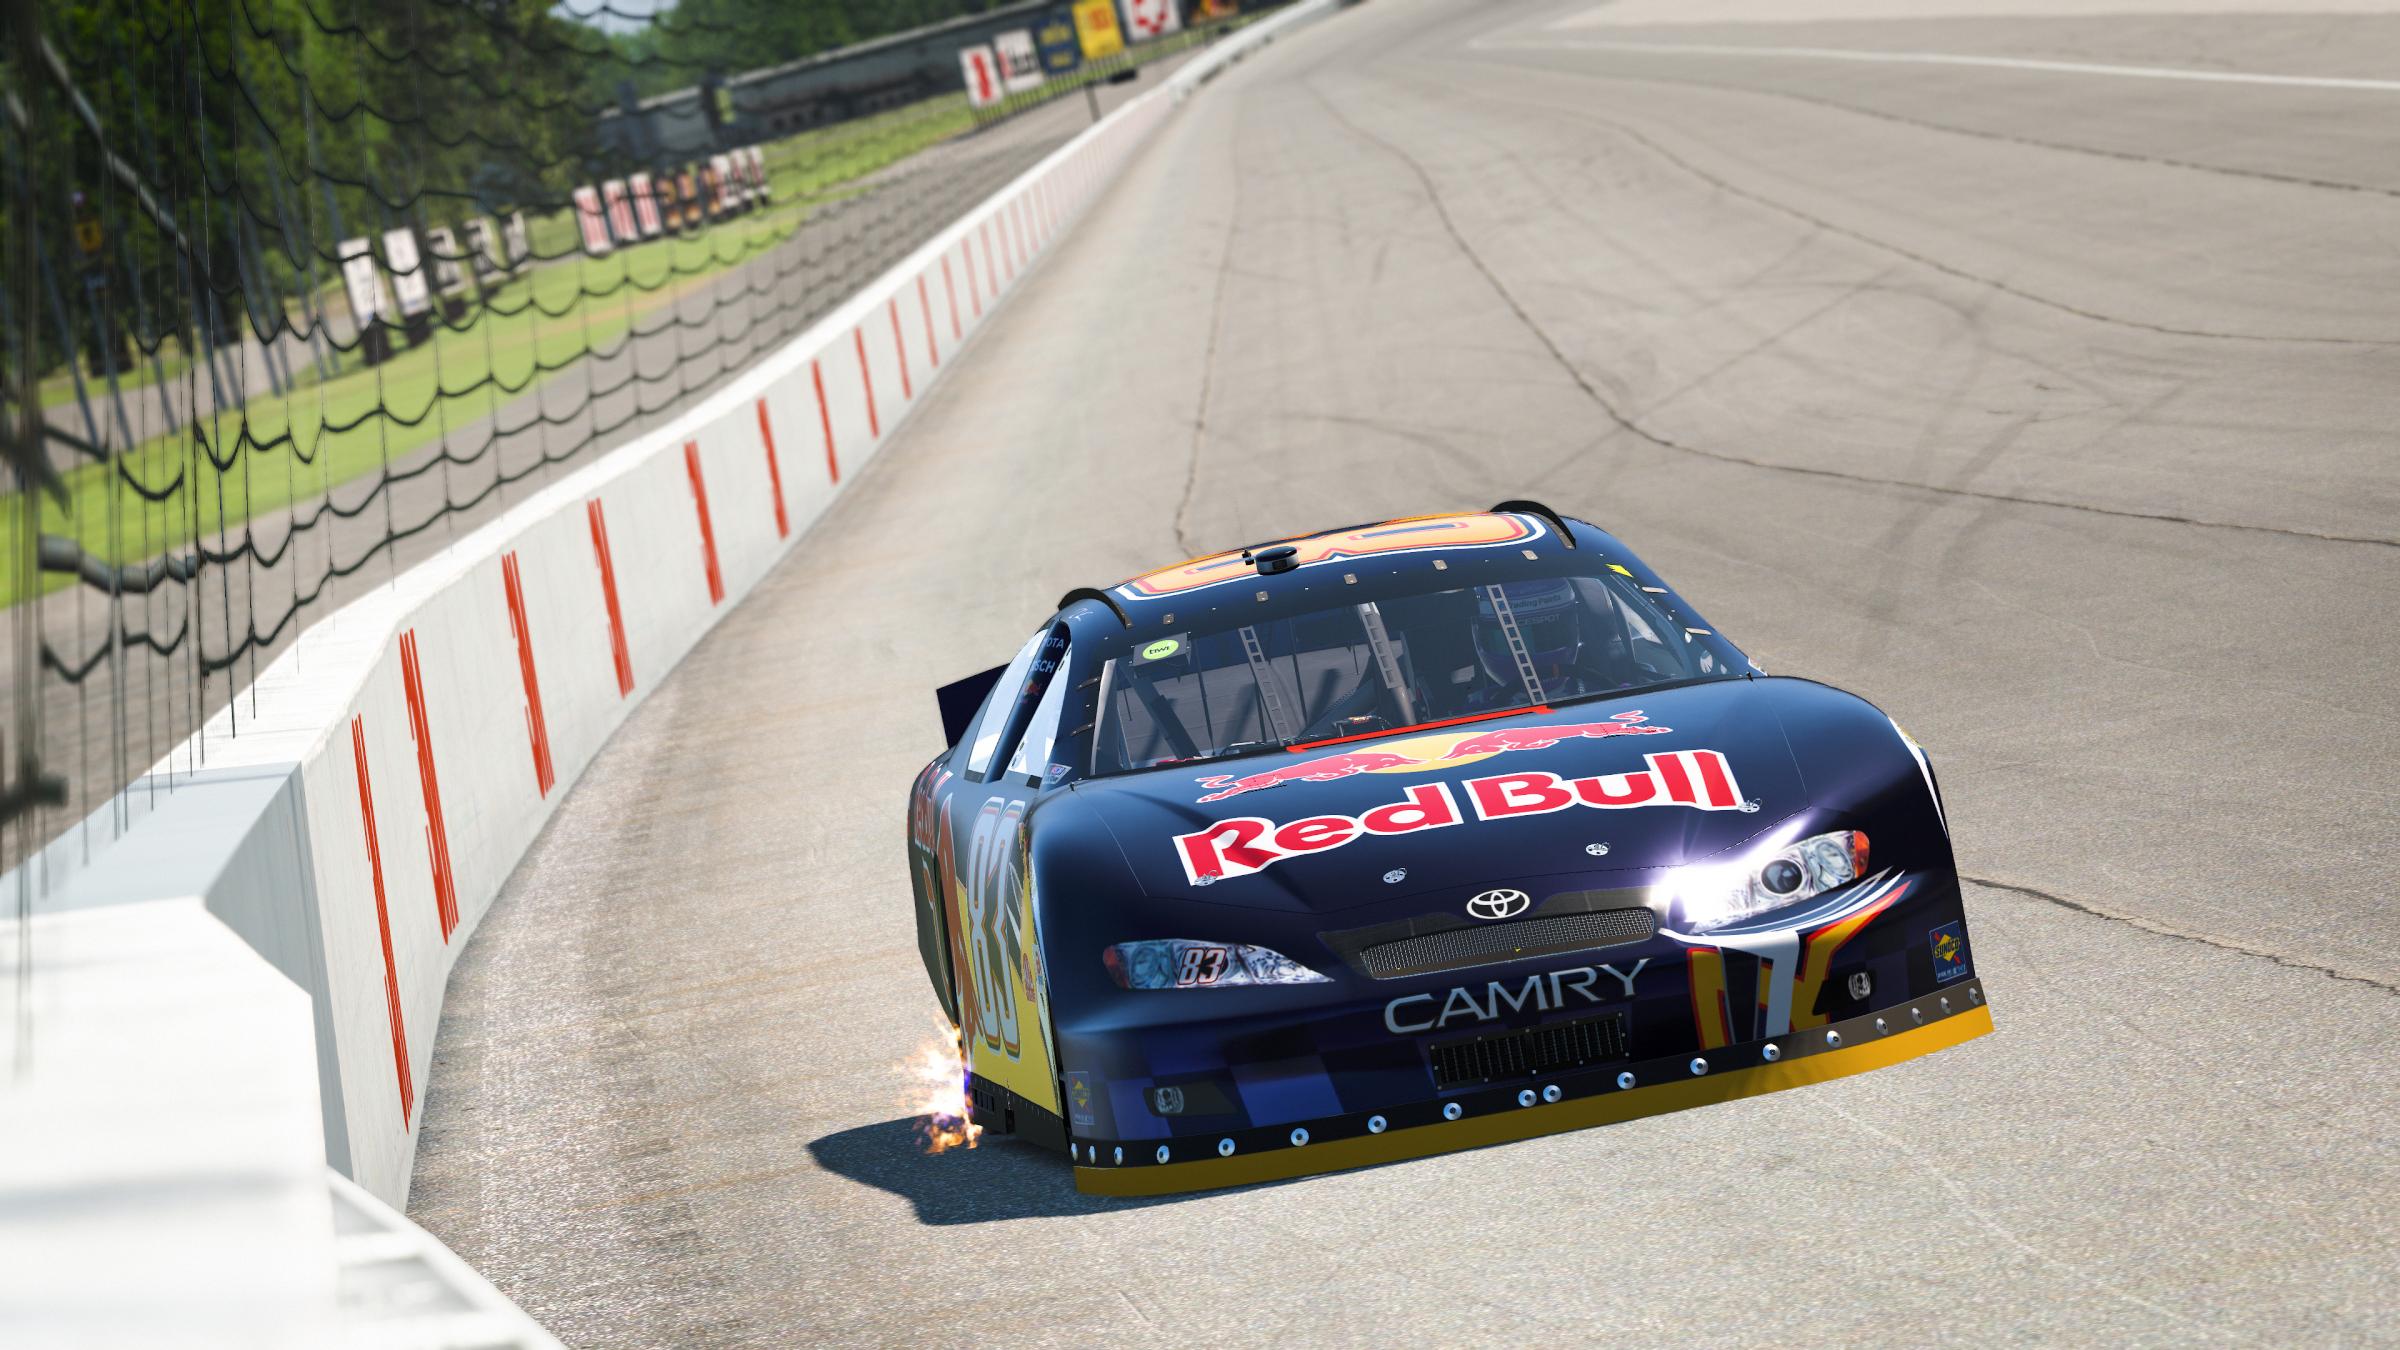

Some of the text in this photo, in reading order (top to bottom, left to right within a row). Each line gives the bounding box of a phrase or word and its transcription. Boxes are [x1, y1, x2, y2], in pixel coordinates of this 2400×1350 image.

[1174, 750, 1744, 885] Red Bull
[967, 796, 1026, 1064] 83
[1178, 948, 1226, 985] 83
[1384, 958, 1652, 1034] CAMRY
